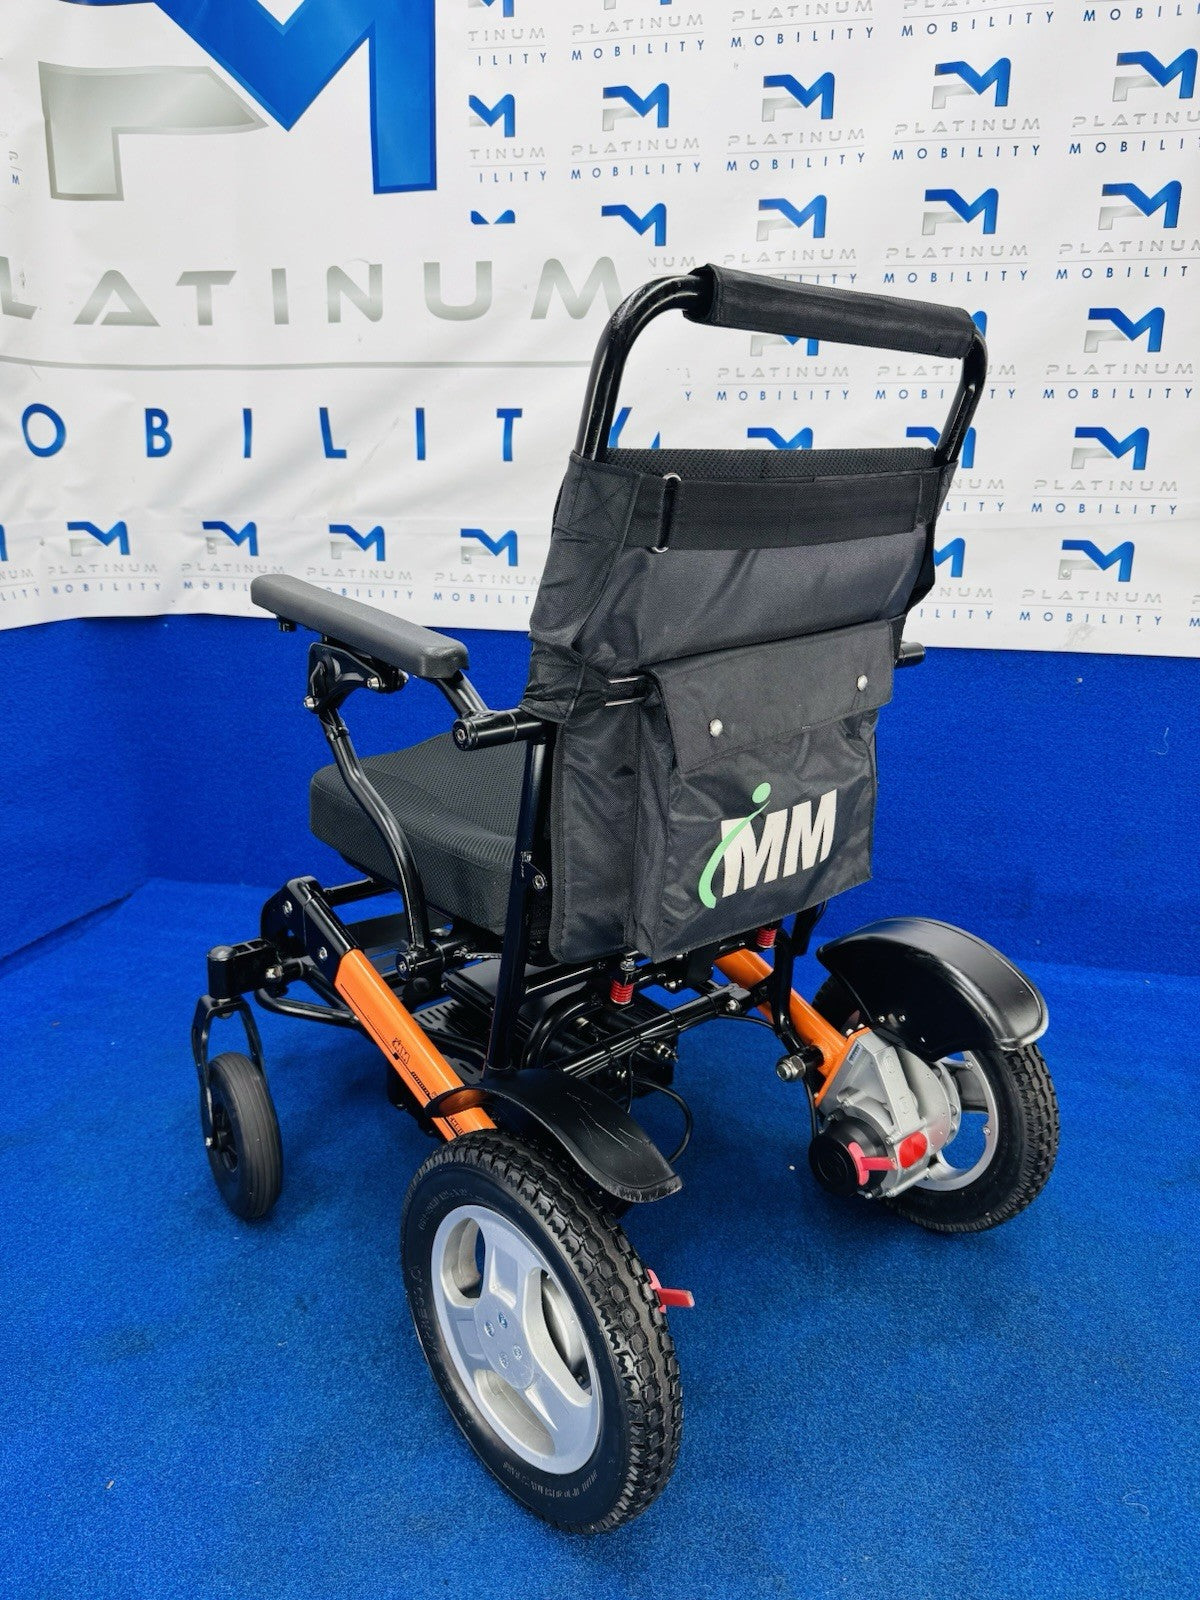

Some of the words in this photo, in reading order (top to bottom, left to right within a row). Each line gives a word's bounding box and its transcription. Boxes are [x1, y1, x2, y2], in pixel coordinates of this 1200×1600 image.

[731, 0, 874, 22] PLATINUM
[571, 14, 704, 35] PLATINUM
[901, 11, 1053, 36] MOBILITY
[731, 26, 874, 48] MOBILITY
[571, 40, 705, 61] MOBILITY
[894, 117, 1041, 136] PLATINUM
[727, 128, 866, 147] PLATINUM
[571, 137, 700, 156] PLATINUM
[892, 144, 1041, 160] MOBILITY
[1069, 138, 1200, 154] MOBILI
[726, 152, 866, 172] MOBILITY
[570, 162, 700, 180] MOBILITY
[723, 248, 857, 265] PLATINUM
[885, 244, 1028, 259] PLATINUM
[883, 270, 1028, 284] MOBILITY
[717, 366, 849, 379] PLATINUM
[877, 364, 1017, 377] PLATIM
[1045, 362, 1194, 376] PLATINUM
[716, 390, 849, 401] MOBILITY
[875, 388, 1017, 400] MOBITY
[1043, 387, 1193, 400] MOBILITY
[1032, 479, 1179, 493] PLATINUM
[1031, 502, 1178, 516] MOBILITY
[47, 563, 159, 575] PLATINUM
[306, 567, 413, 581] PLATINUM
[183, 580, 249, 592] MOBIL
[326, 587, 414, 599] BILITY
[432, 592, 530, 605] MOBILIT
[1021, 589, 1163, 604] PLATINUM
[919, 608, 994, 620] ILITY
[1018, 611, 1162, 626] MOBILITY
